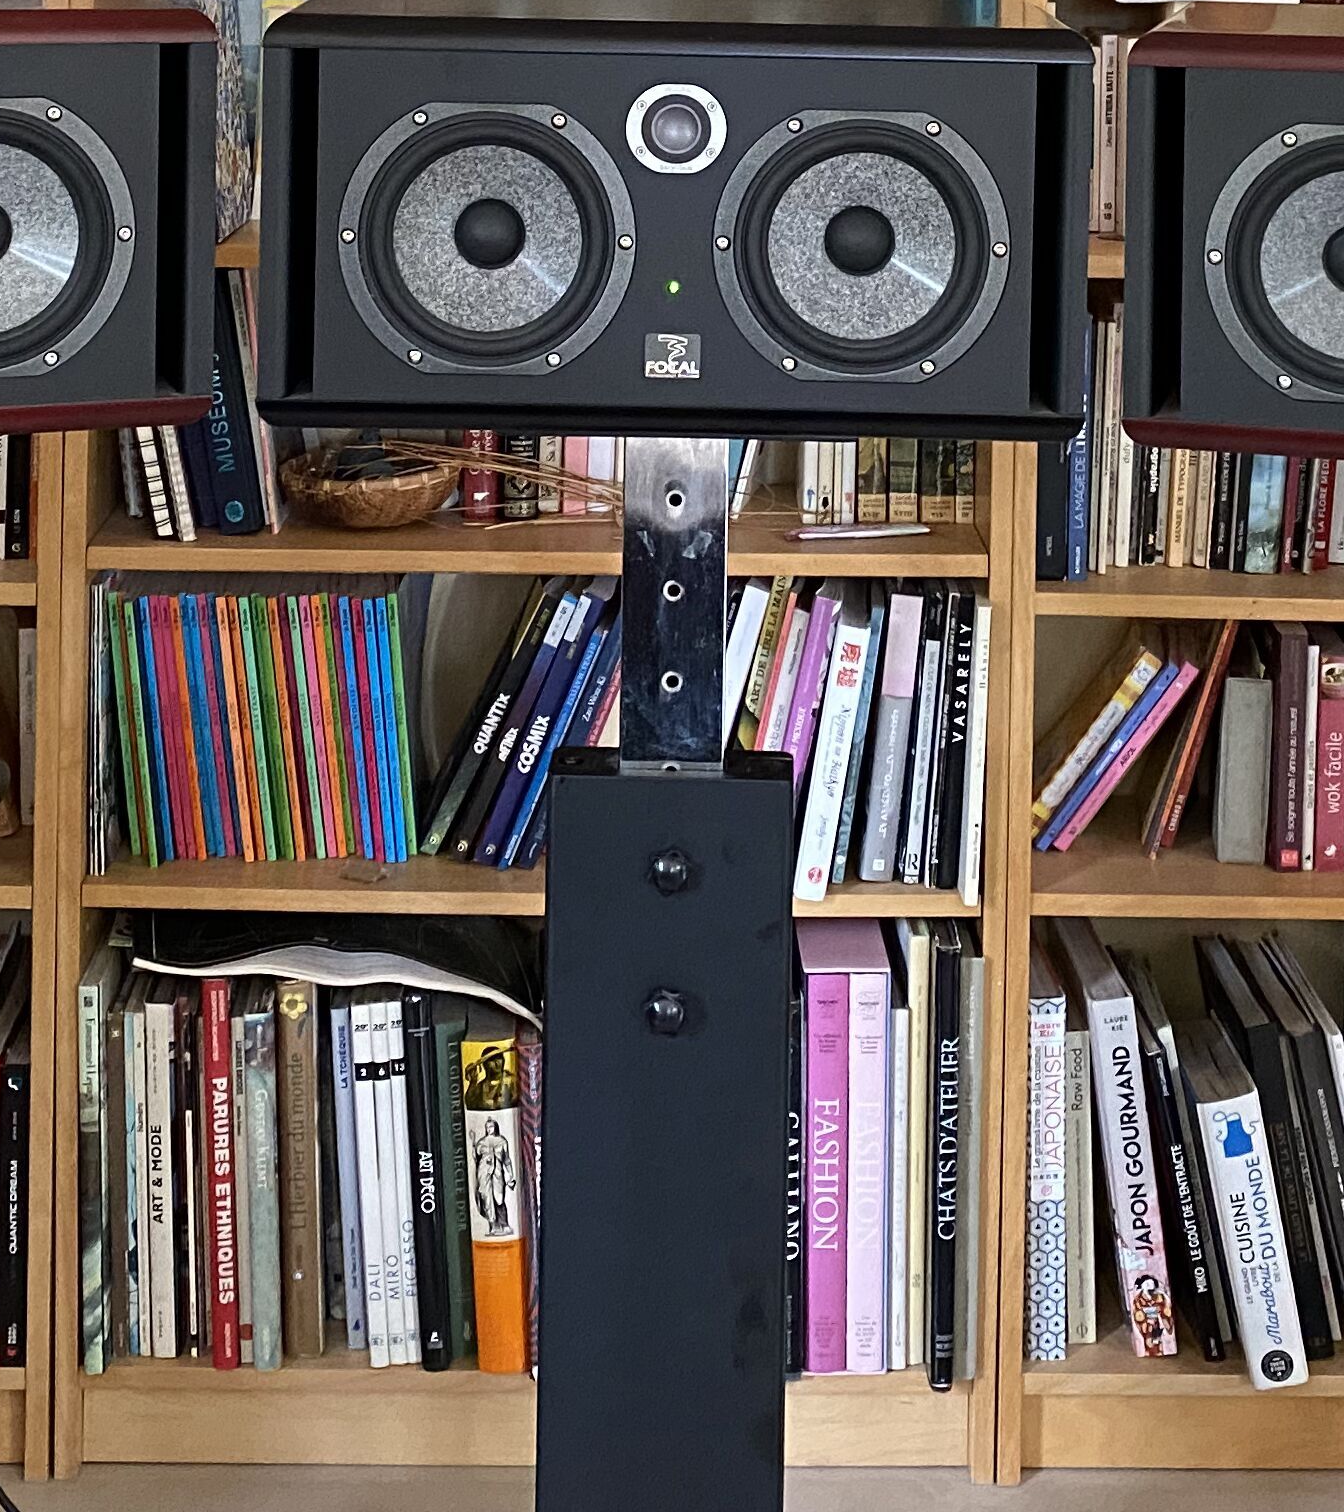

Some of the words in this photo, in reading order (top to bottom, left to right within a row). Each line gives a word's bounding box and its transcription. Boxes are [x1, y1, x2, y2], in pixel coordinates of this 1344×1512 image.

[645, 360, 699, 376] FOCAL
[951, 622, 973, 743] VASARELY
[471, 692, 512, 755] QUANTIX
[516, 715, 551, 775] COSMIX
[1324, 732, 1343, 778] facile
[1325, 783, 1342, 814] wok
[287, 1053, 303, 1116] monde
[1070, 1048, 1083, 1080] Food
[210, 1076, 231, 1177] PARURES
[937, 1037, 960, 1155] D'ATELIER
[1044, 1045, 1063, 1170] JAPONAISE
[1071, 1083, 1083, 1111] Raw
[1112, 1045, 1145, 1178] GOURMAND
[150, 1124, 163, 1172] MODE
[289, 1118, 305, 1142] du
[9, 1159, 18, 1202] DREAM
[152, 1176, 163, 1187] &
[289, 1144, 307, 1231] L'Herbier
[418, 1151, 434, 1174] ART
[811, 1098, 841, 1251] FASHION
[1245, 1154, 1271, 1228] MONDE
[152, 1192, 164, 1224] ART
[419, 1176, 436, 1214] DECO
[937, 1160, 958, 1240] CHATS
[1128, 1183, 1155, 1256] JAPON
[8, 1204, 18, 1254] QUANTIC
[215, 1182, 235, 1305] ETHNIQUES
[1229, 1191, 1255, 1265] CUISINE
[1258, 1232, 1277, 1259] DU
[1256, 1263, 1282, 1345] Marabout
